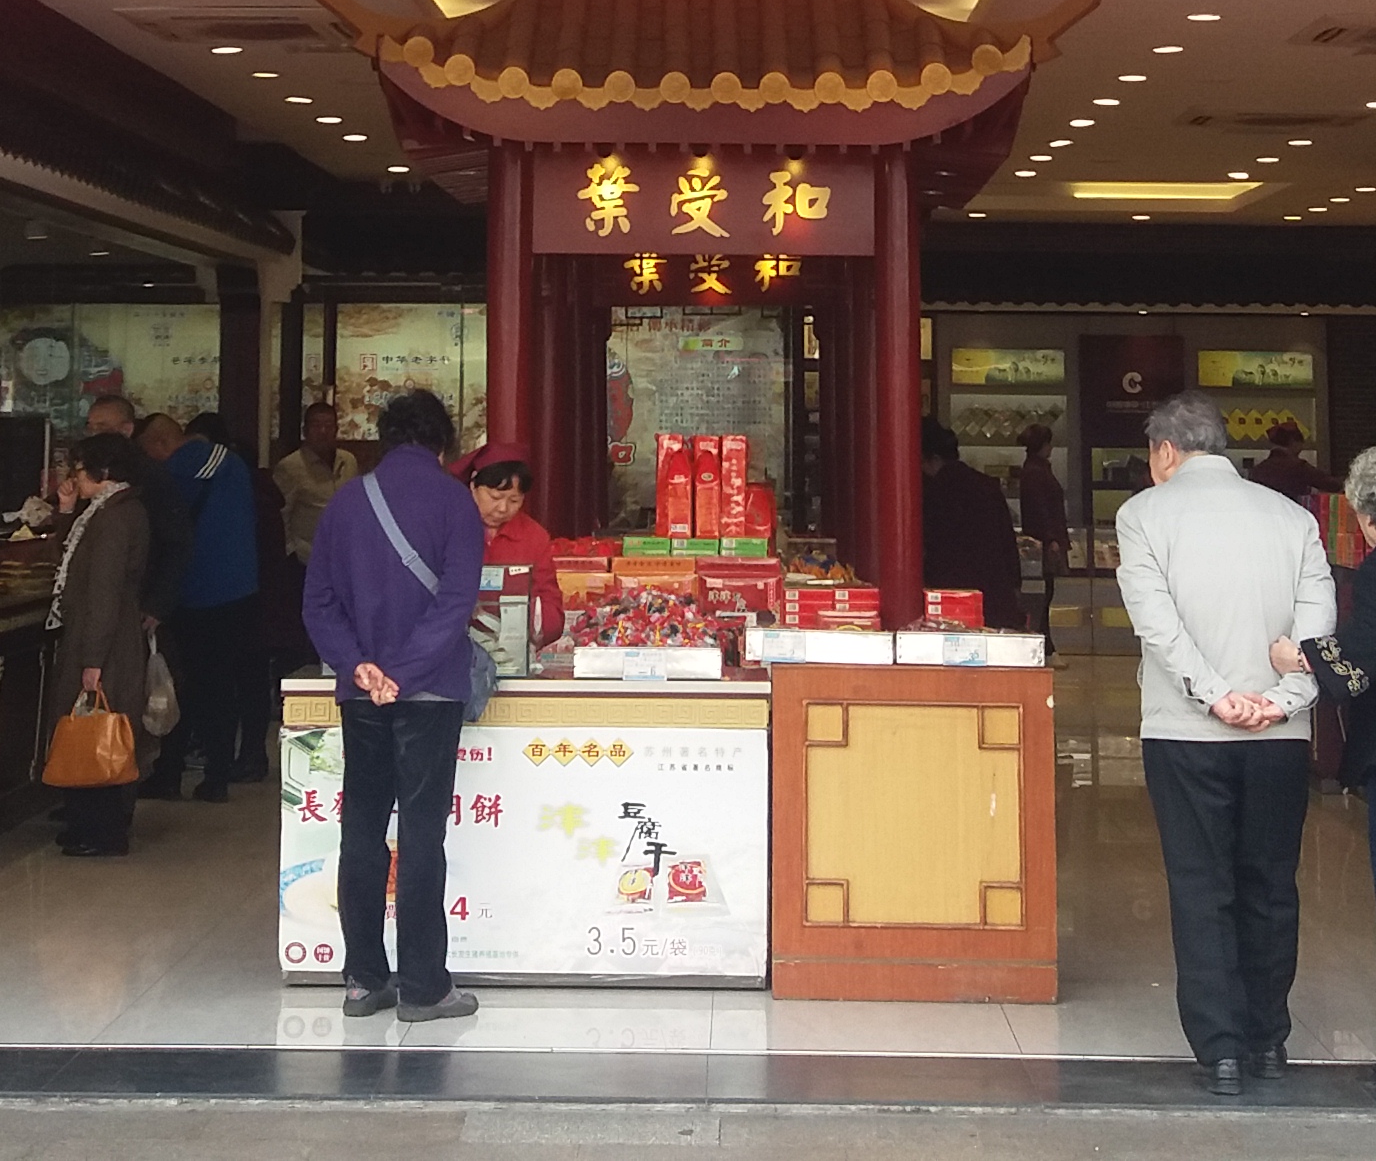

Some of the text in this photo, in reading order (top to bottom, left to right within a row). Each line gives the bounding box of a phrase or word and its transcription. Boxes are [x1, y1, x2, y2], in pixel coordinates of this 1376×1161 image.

[576, 162, 832, 239] 葉受和
[623, 252, 803, 296] 葉受和
[528, 742, 628, 759] 百年名品
[644, 746, 743, 759] 苏州著名特产
